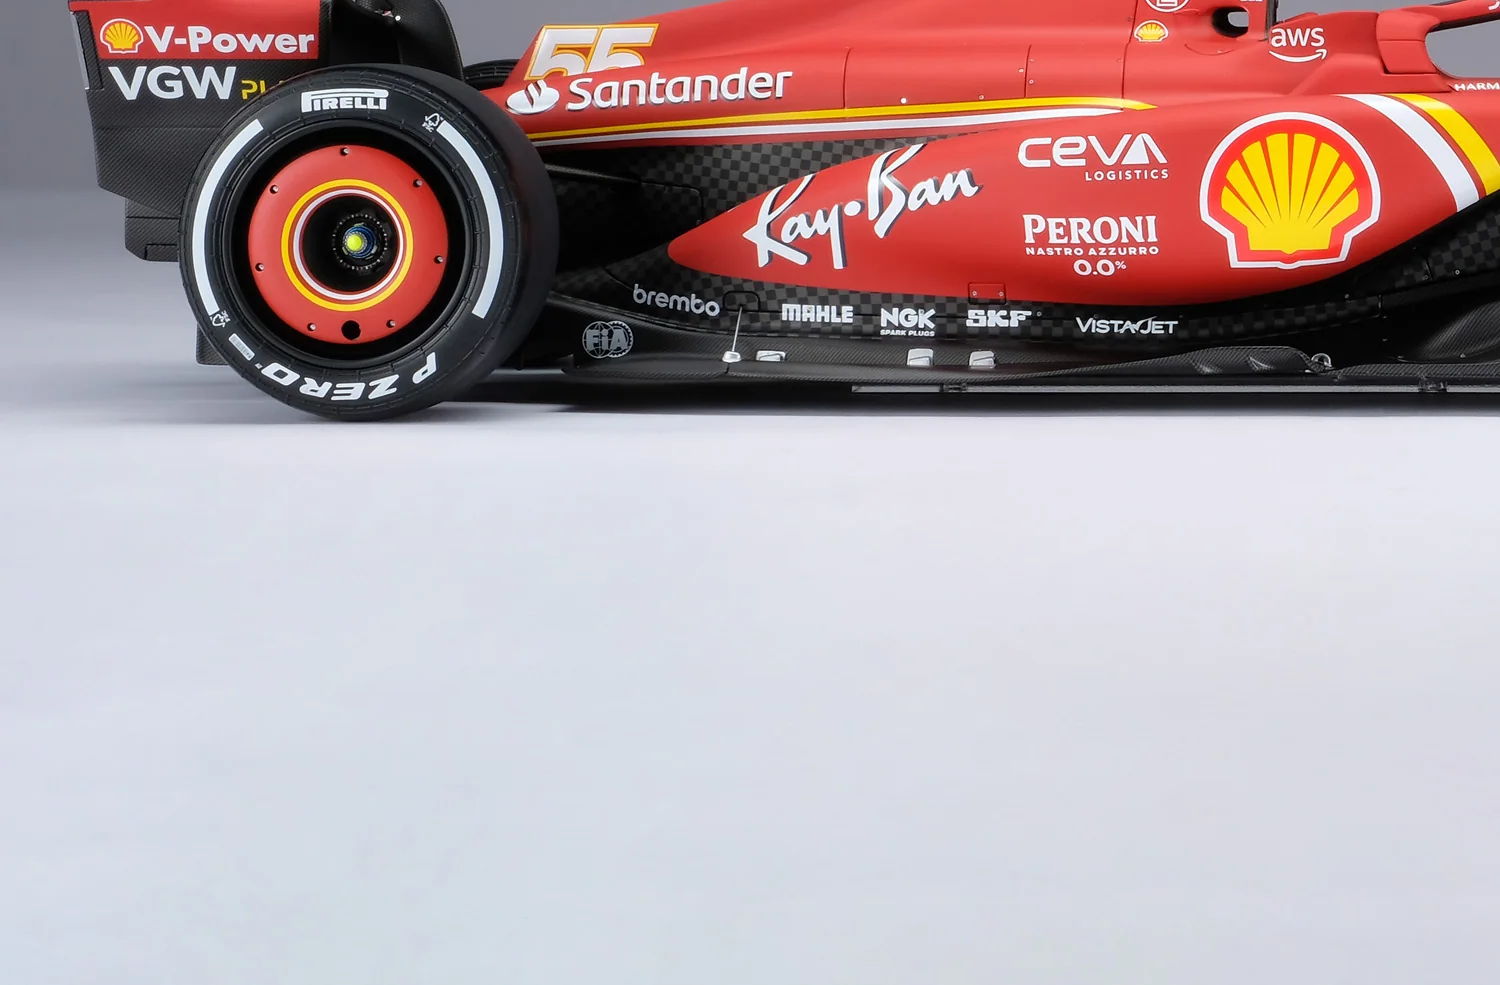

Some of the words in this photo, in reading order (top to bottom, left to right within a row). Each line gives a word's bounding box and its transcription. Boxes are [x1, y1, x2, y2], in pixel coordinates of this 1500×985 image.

[144, 25, 315, 54] V-Power
[1271, 27, 1325, 48] aws
[108, 66, 237, 101] VGW
[566, 67, 793, 112] Santander
[301, 88, 389, 113] PIRELLI
[1085, 169, 1169, 182] LOGISTICS
[1022, 214, 1158, 245] PERONI
[1025, 247, 1084, 257] NASTRO
[1088, 246, 1159, 256] AZZURRO
[1073, 259, 1127, 277] 0.0%
[633, 284, 720, 317] brembo
[781, 304, 854, 324] MAHLE
[880, 307, 936, 329] NGK
[966, 309, 1032, 328] SKF
[412, 351, 437, 384] P
[261, 362, 400, 401] ZERO
